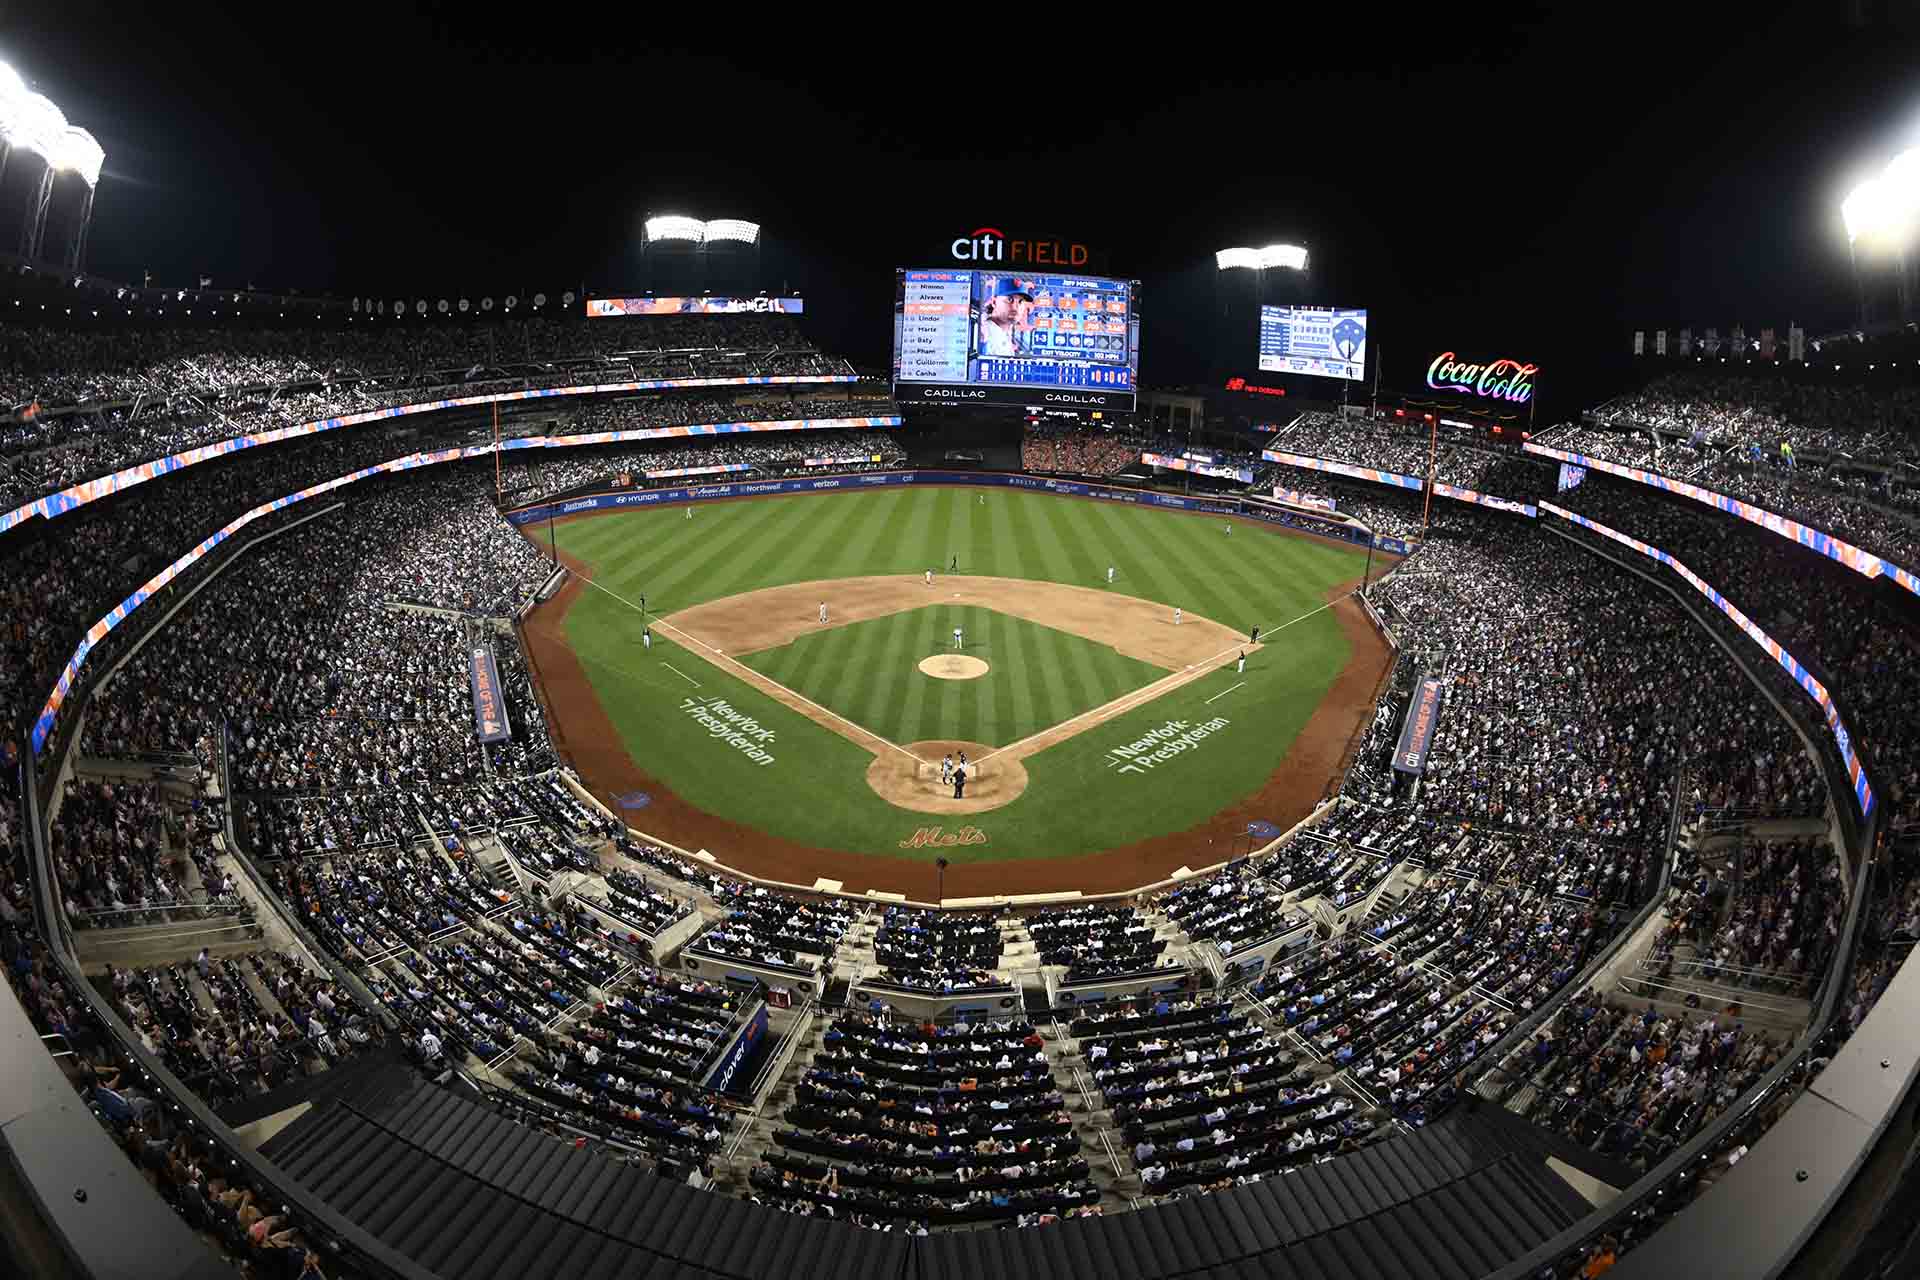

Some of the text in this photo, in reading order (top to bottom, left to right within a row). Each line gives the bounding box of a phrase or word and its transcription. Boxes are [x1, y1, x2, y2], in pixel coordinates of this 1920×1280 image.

[951, 234, 1088, 265] citi FIELD
[1055, 350, 1081, 358] VELOCITY
[923, 389, 986, 398] CADILLAC
[1045, 393, 1106, 404] CADILLAC
[746, 483, 781, 493] Northwell
[813, 480, 840, 488] verizon
[628, 494, 660, 503] HYUNDAI
[563, 499, 598, 513] Justworks
[686, 705, 776, 766] Presbyterian
[1134, 717, 1231, 768] Presbyterian
[899, 825, 987, 849] Mets
[719, 1041, 745, 1092] clover
